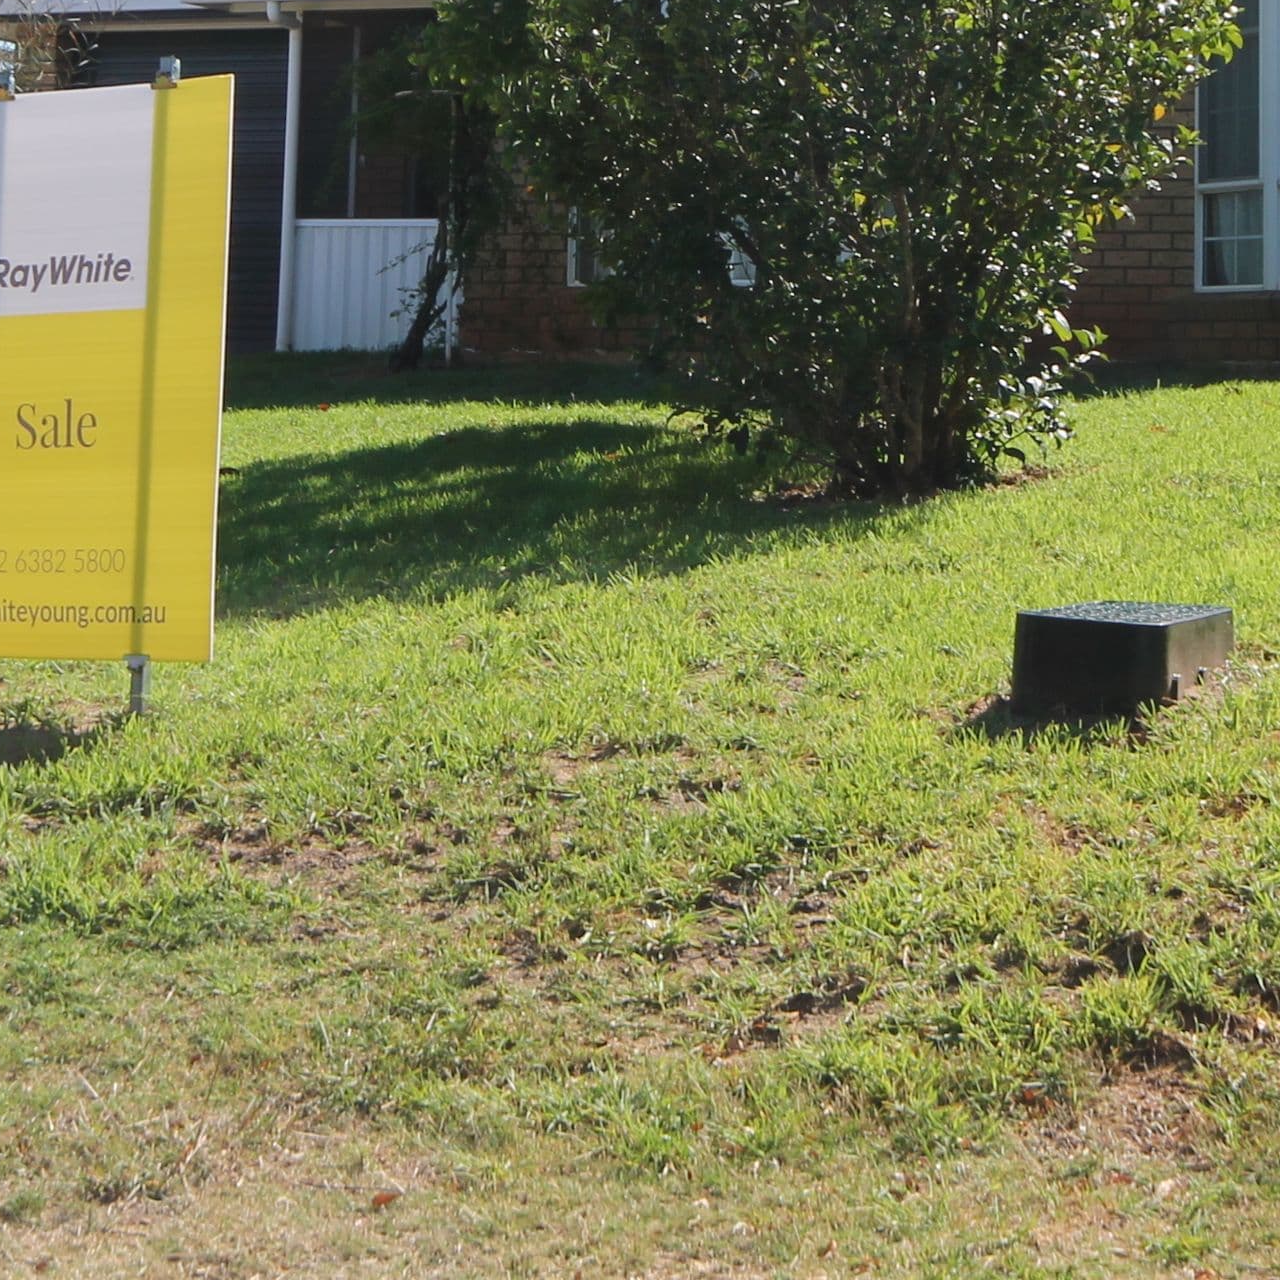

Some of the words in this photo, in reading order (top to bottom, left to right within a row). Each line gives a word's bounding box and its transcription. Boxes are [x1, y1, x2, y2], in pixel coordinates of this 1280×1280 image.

[15, 398, 97, 450] Sale
[15, 548, 66, 573] 6382
[72, 547, 126, 573] 5800
